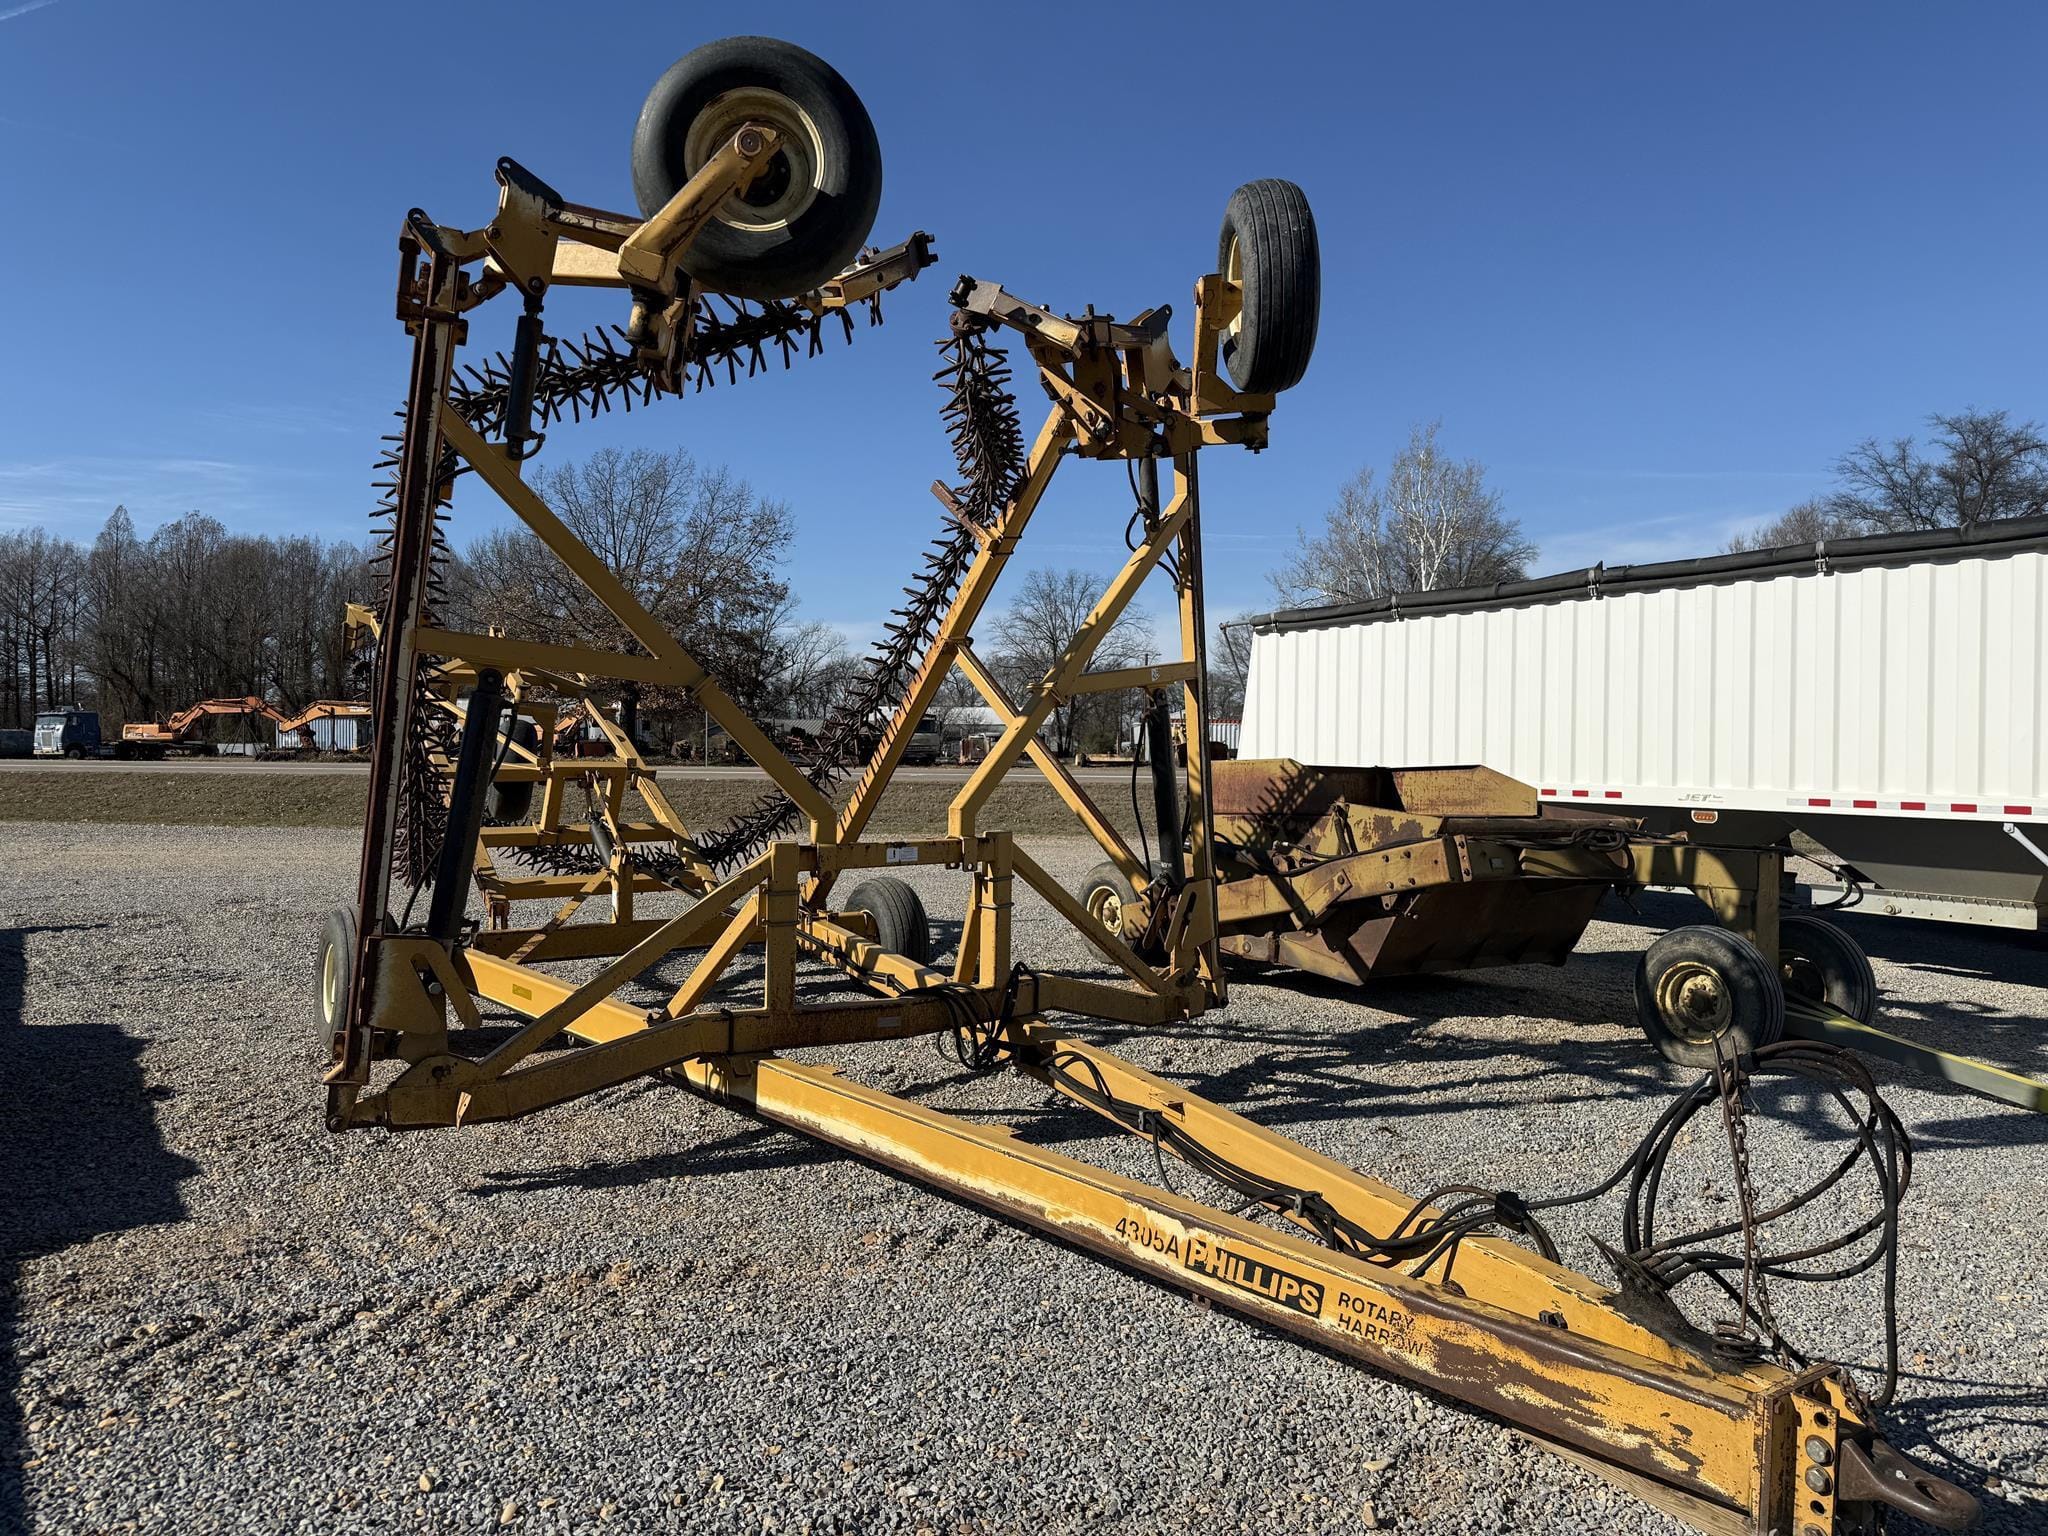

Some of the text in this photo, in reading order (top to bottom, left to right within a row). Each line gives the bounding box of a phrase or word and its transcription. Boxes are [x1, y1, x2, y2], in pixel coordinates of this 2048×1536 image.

[1186, 1239, 1320, 1314] PHILLIPS
[1337, 1291, 1415, 1330] ROTARY
[1337, 1313, 1424, 1357] HARROW
